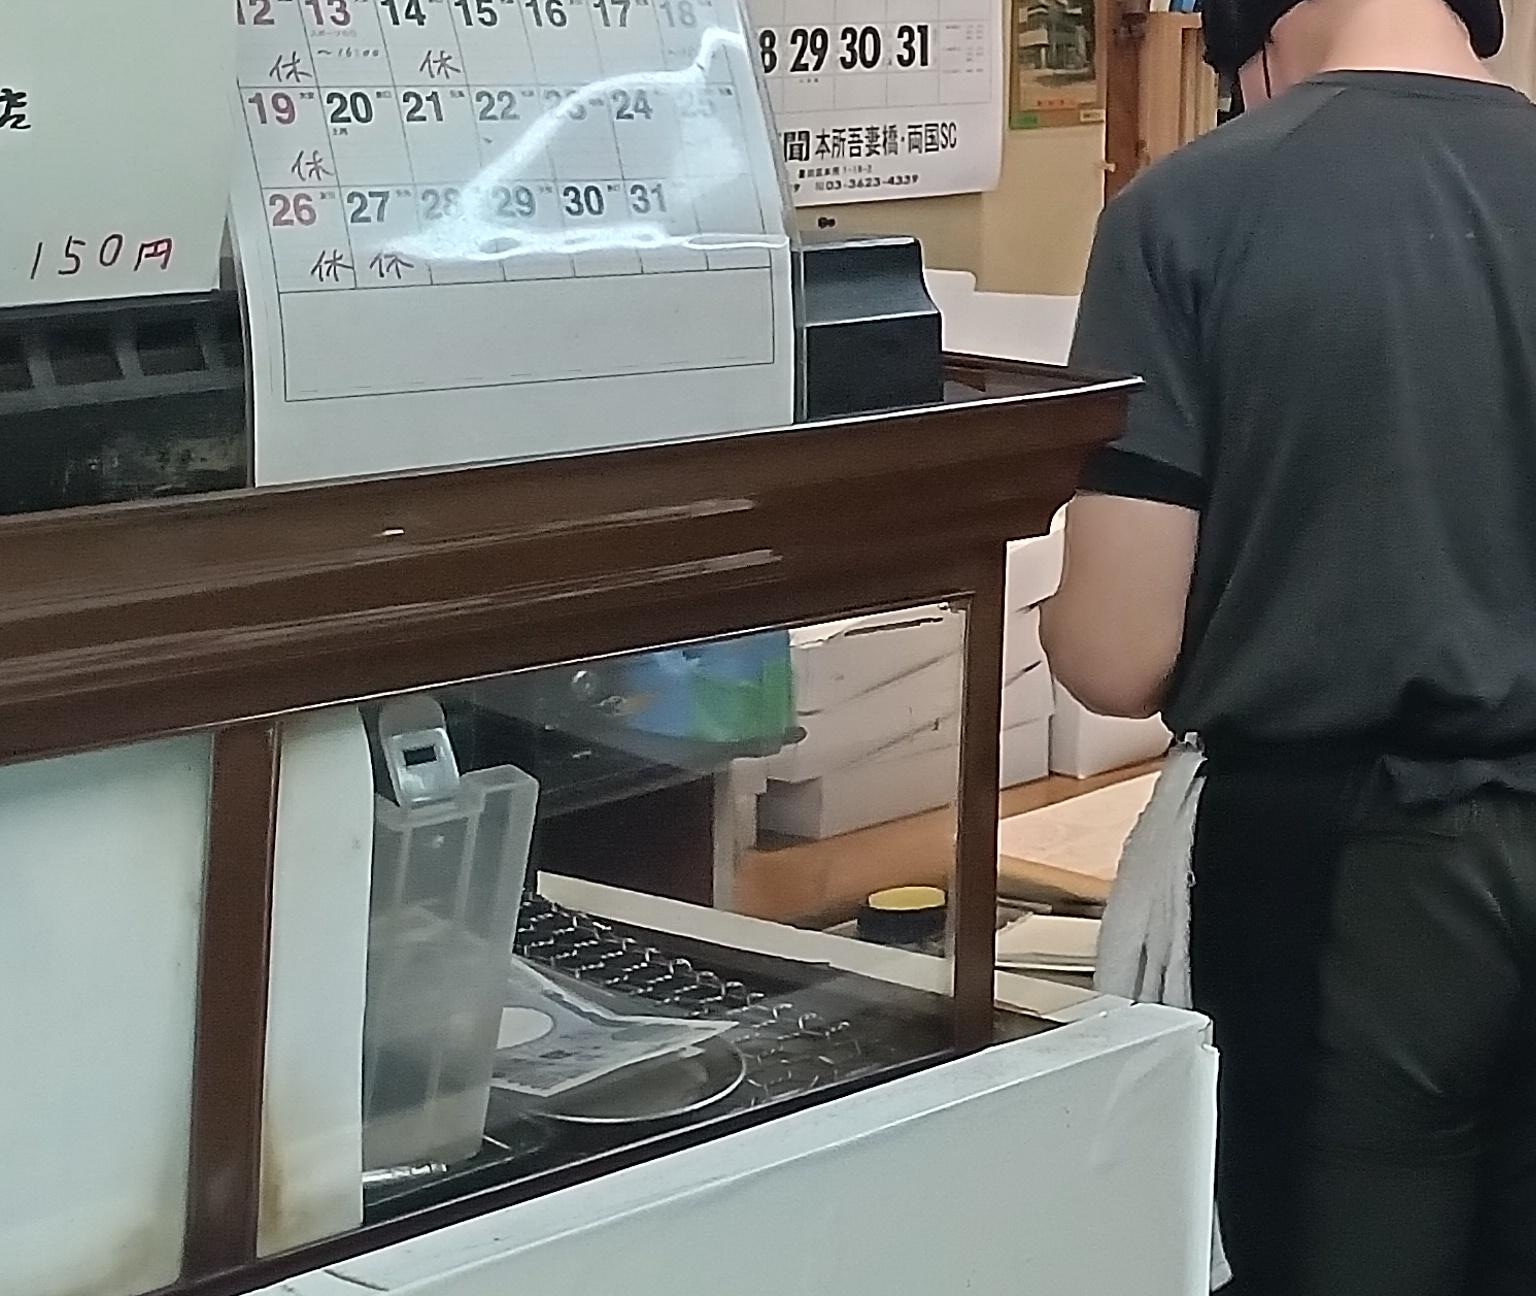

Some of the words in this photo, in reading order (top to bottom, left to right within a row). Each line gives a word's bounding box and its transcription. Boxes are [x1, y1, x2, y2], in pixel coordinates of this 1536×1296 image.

[660, 0, 697, 28] 18
[419, 50, 462, 80] 休
[758, 29, 778, 75] 8
[790, 27, 829, 73] 29
[840, 25, 882, 70] 30
[896, 24, 930, 68] 31
[269, 51, 312, 82] 休
[248, 92, 297, 124] 19
[326, 92, 373, 124] 20
[402, 90, 443, 122] 21
[475, 90, 520, 121] 22
[612, 89, 653, 120] 24
[291, 150, 335, 181] 休
[269, 192, 317, 226] 26
[346, 191, 390, 223] 27
[492, 184, 537, 218] 29
[563, 185, 605, 217] 30
[630, 183, 667, 215] 31
[31, 234, 172, 280] 150円
[310, 249, 355, 282] 休
[369, 252, 415, 280] 休
